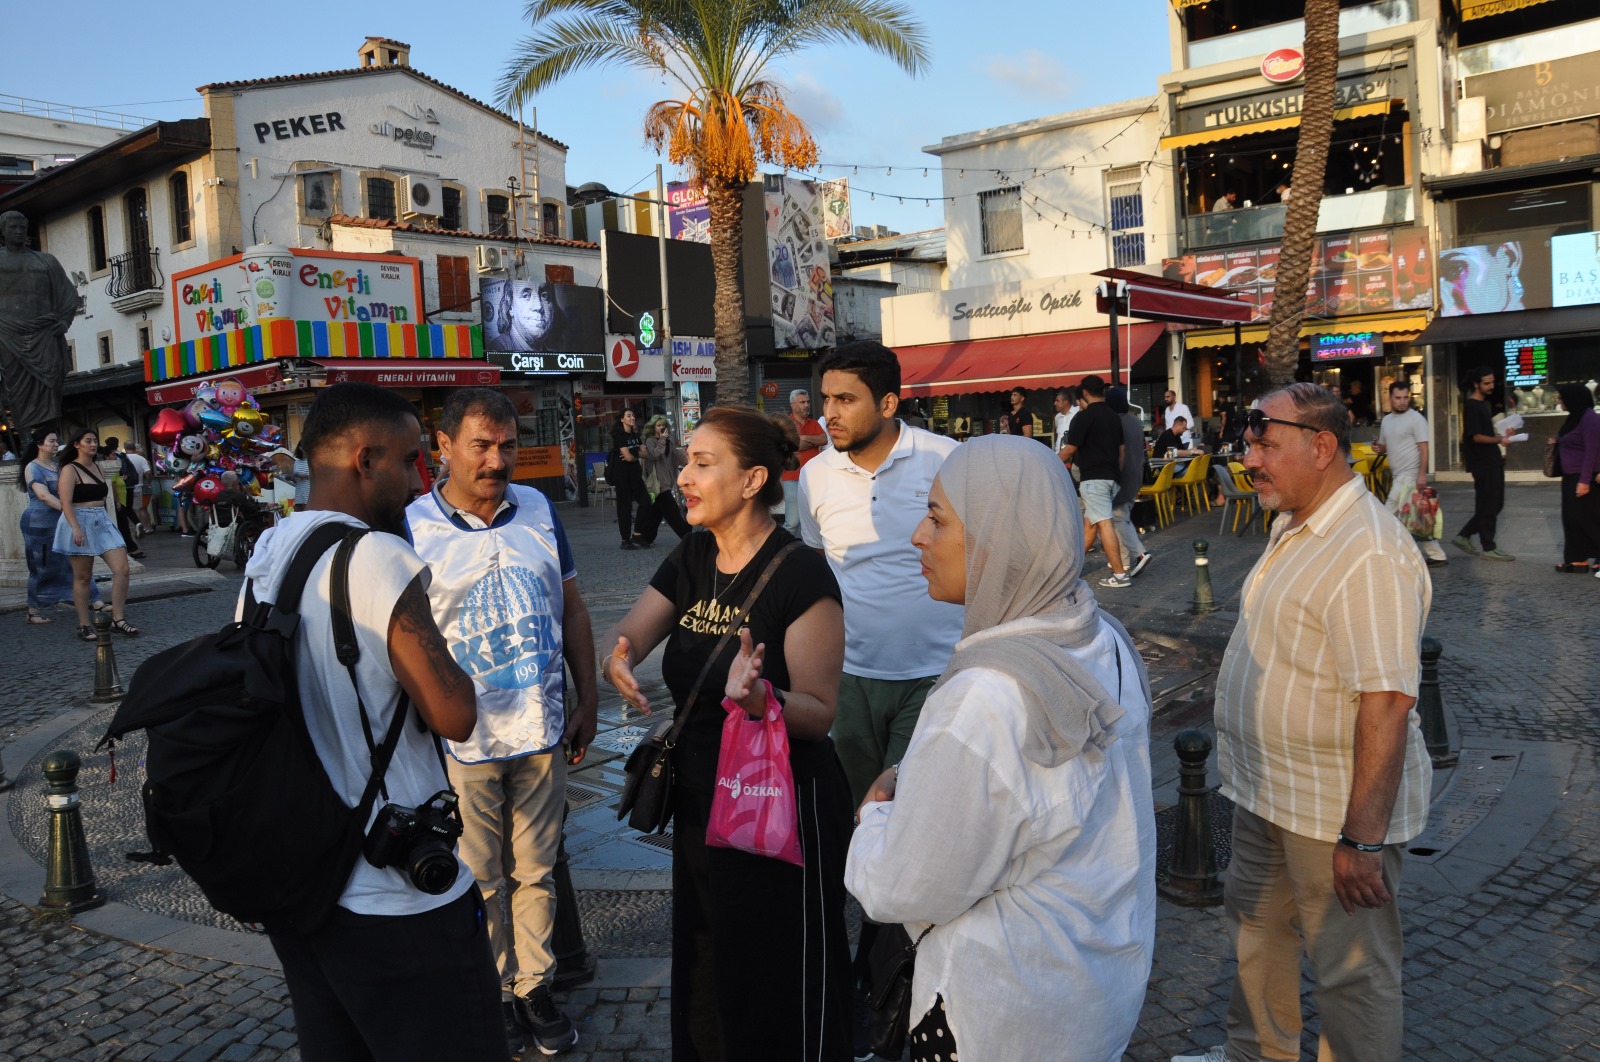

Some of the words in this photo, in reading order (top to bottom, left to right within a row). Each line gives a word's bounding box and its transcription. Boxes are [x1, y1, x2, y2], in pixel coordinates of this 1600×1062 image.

[254, 111, 345, 144] PEKER
[381, 265, 400, 273] DEVREN
[1560, 268, 1600, 285] BAŞ
[299, 264, 371, 295] enerji
[183, 278, 223, 305] enerji
[1040, 290, 1082, 315] Optik
[1320, 335, 1345, 346] KING
[1347, 332, 1372, 344] CHEF
[1317, 346, 1376, 358] RESTORAT
[511, 353, 544, 371] Çarşı
[557, 354, 584, 368] Coin
[681, 365, 712, 375] corendon
[377, 371, 414, 382] ENERJİ
[417, 370, 456, 382] VİTAMİN
[765, 384, 775, 393] ria
[679, 614, 745, 636] EXCHANE
[451, 614, 557, 676] KESK
[743, 782, 783, 797] ÖZKAN
[431, 825, 448, 834] Nikon
